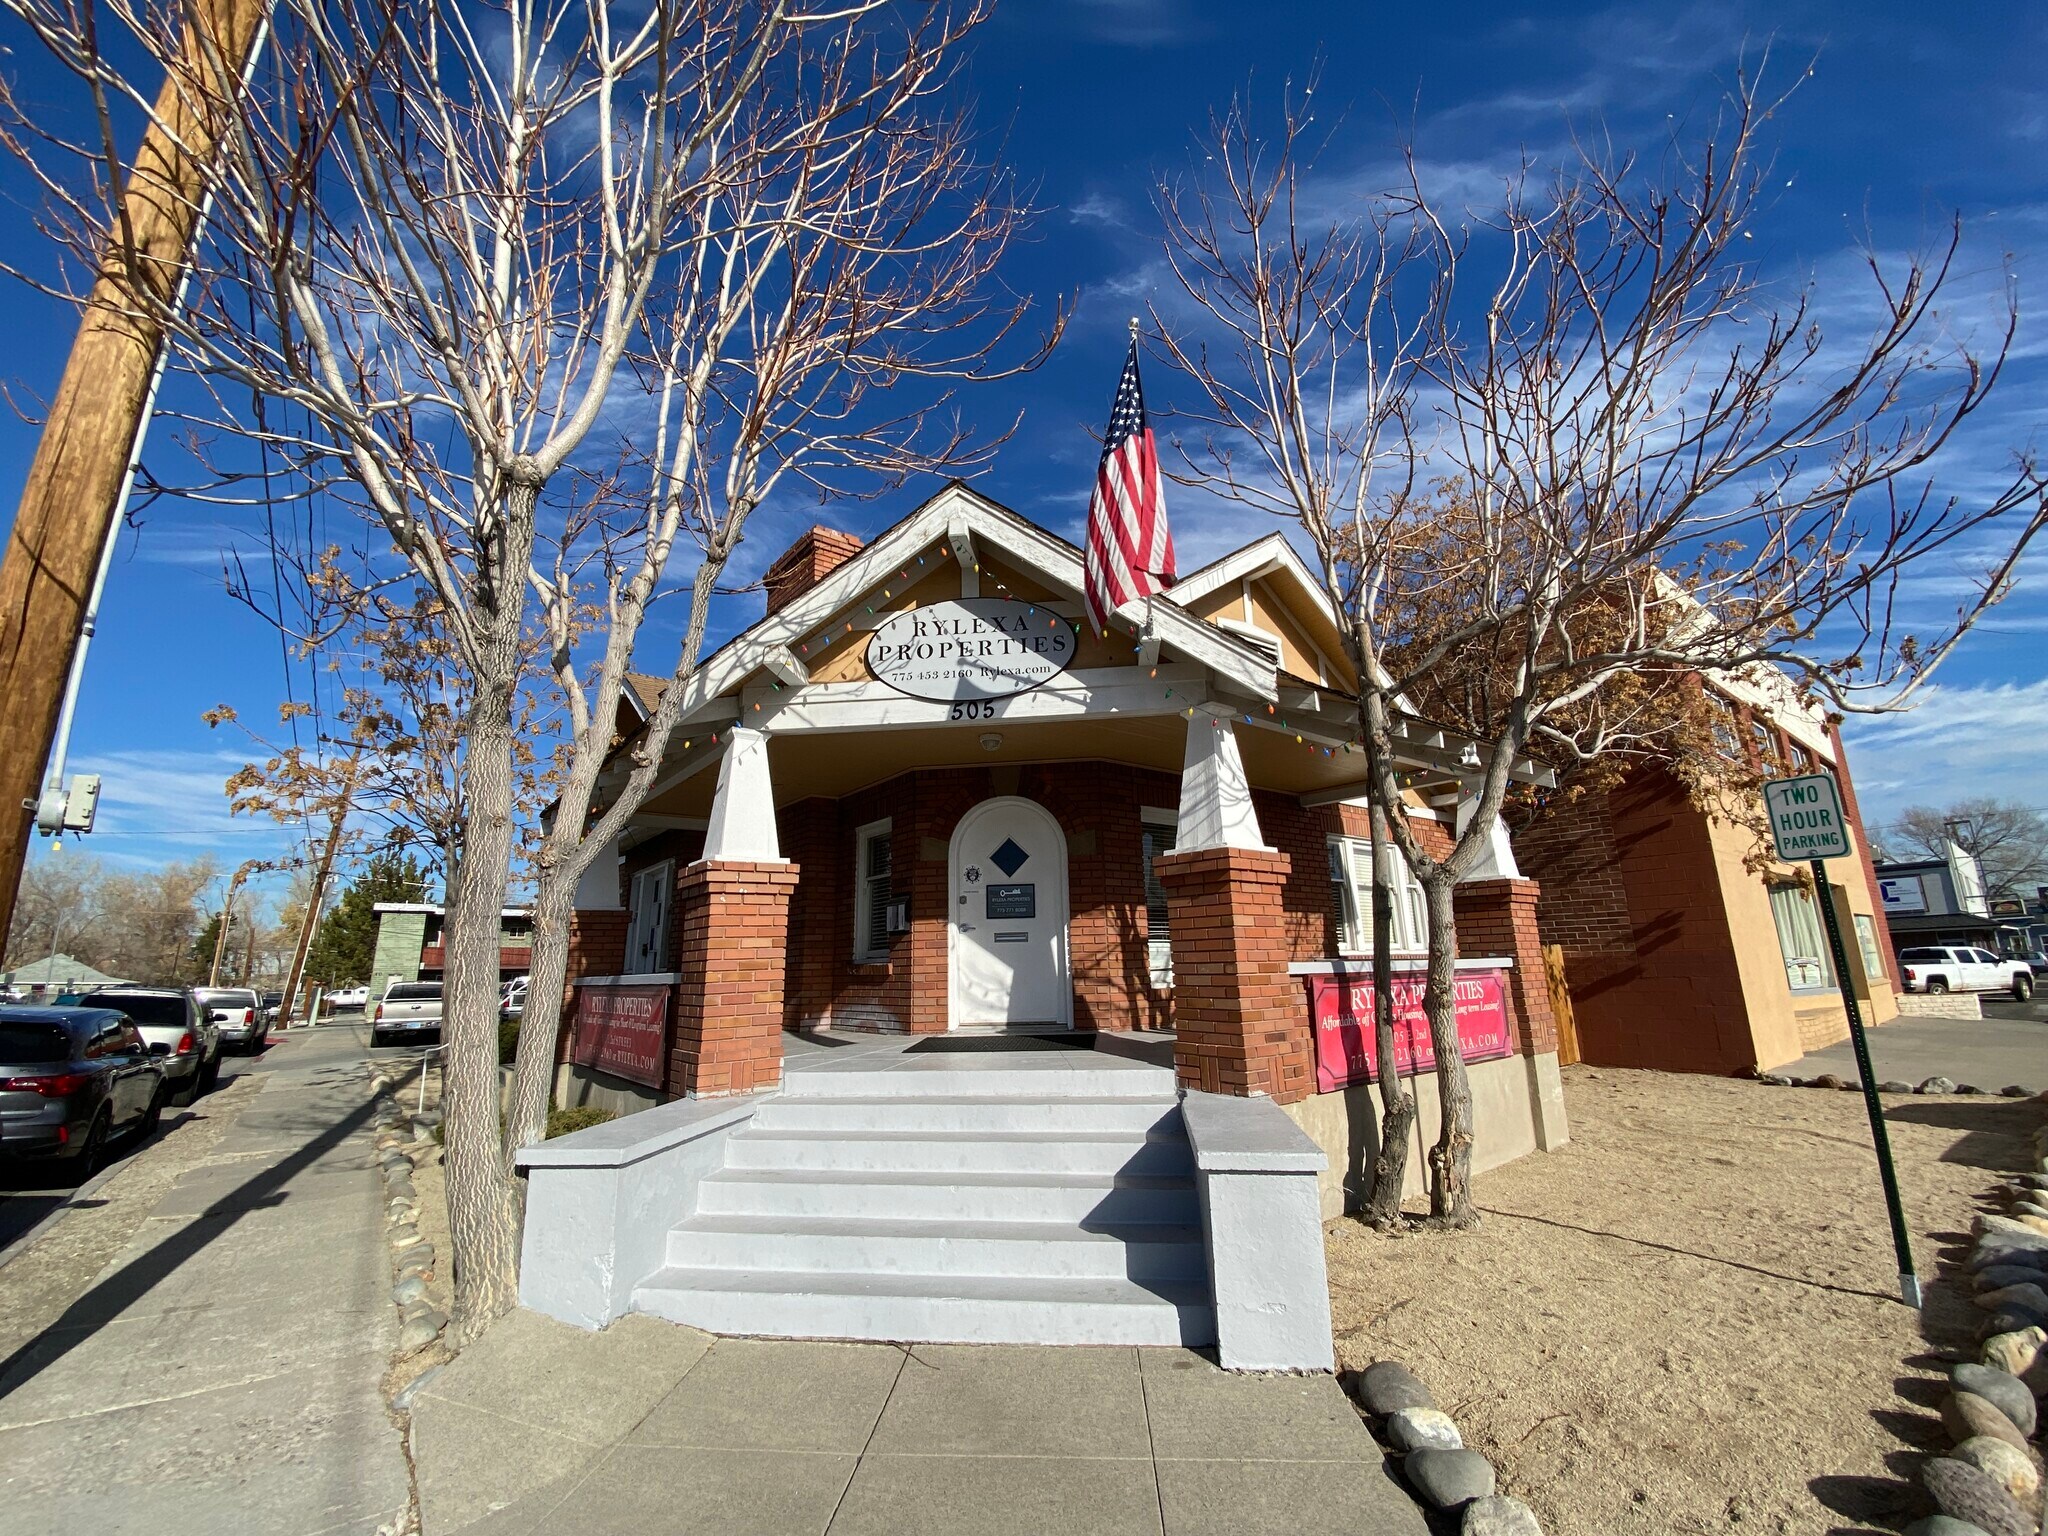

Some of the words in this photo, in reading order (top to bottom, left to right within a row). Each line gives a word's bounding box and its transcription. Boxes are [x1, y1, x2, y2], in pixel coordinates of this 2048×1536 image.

[913, 615, 1029, 637] RYLEXA
[878, 635, 1066, 661] PROPERTIES
[892, 672, 913, 681] 775
[917, 672, 939, 680] 453
[943, 669, 973, 679] 2160
[980, 665, 1051, 680] Rylexa.com
[951, 700, 995, 720] 505
[1780, 785, 1819, 806] TWO
[1779, 809, 1832, 831] HOUR
[1783, 831, 1839, 850] PARKING
[1352, 985, 1409, 1010] RYXA
[1322, 1013, 1360, 1031] Affordable
[1351, 1052, 1370, 1069] 775
[1397, 1045, 1422, 1061] 2160
